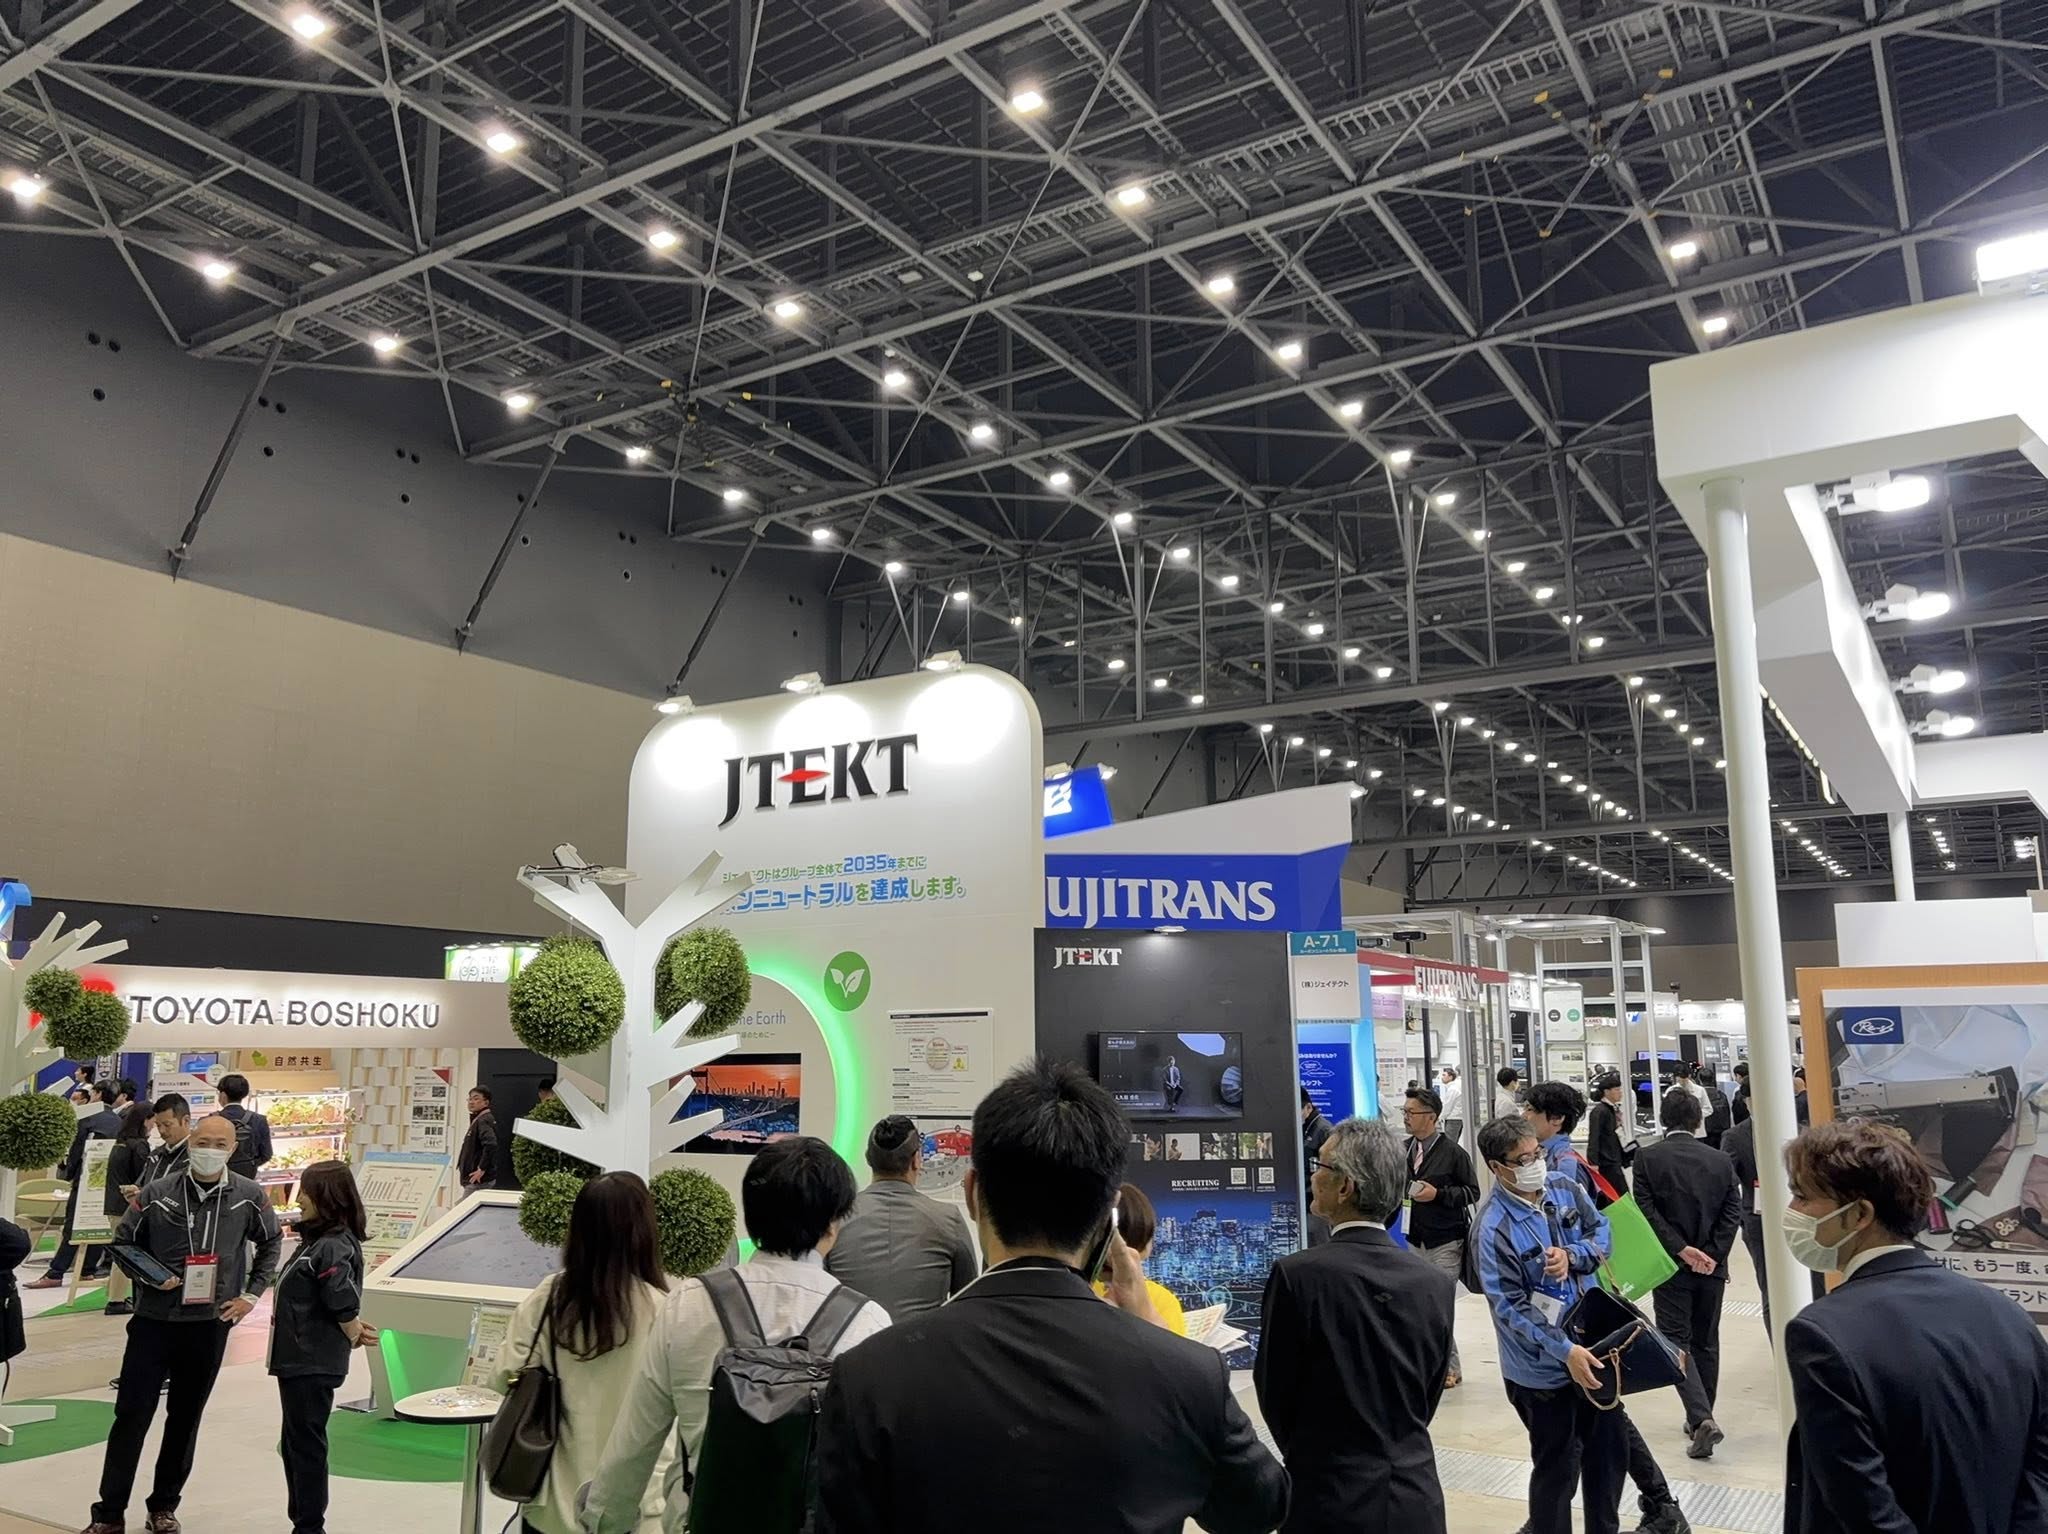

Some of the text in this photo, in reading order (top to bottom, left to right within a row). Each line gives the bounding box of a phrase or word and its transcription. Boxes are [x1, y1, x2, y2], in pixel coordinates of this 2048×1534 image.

[718, 733, 919, 828] JTEKT
[1303, 935, 1339, 947] A-71
[1053, 947, 1122, 968] JTEKT
[130, 995, 441, 1028] TOYOTA BOSHOKU
[757, 1010, 786, 1025] Earth
[274, 1055, 322, 1066] 自然共生
[1934, 1256, 2048, 1276] 材に、もう一度、
